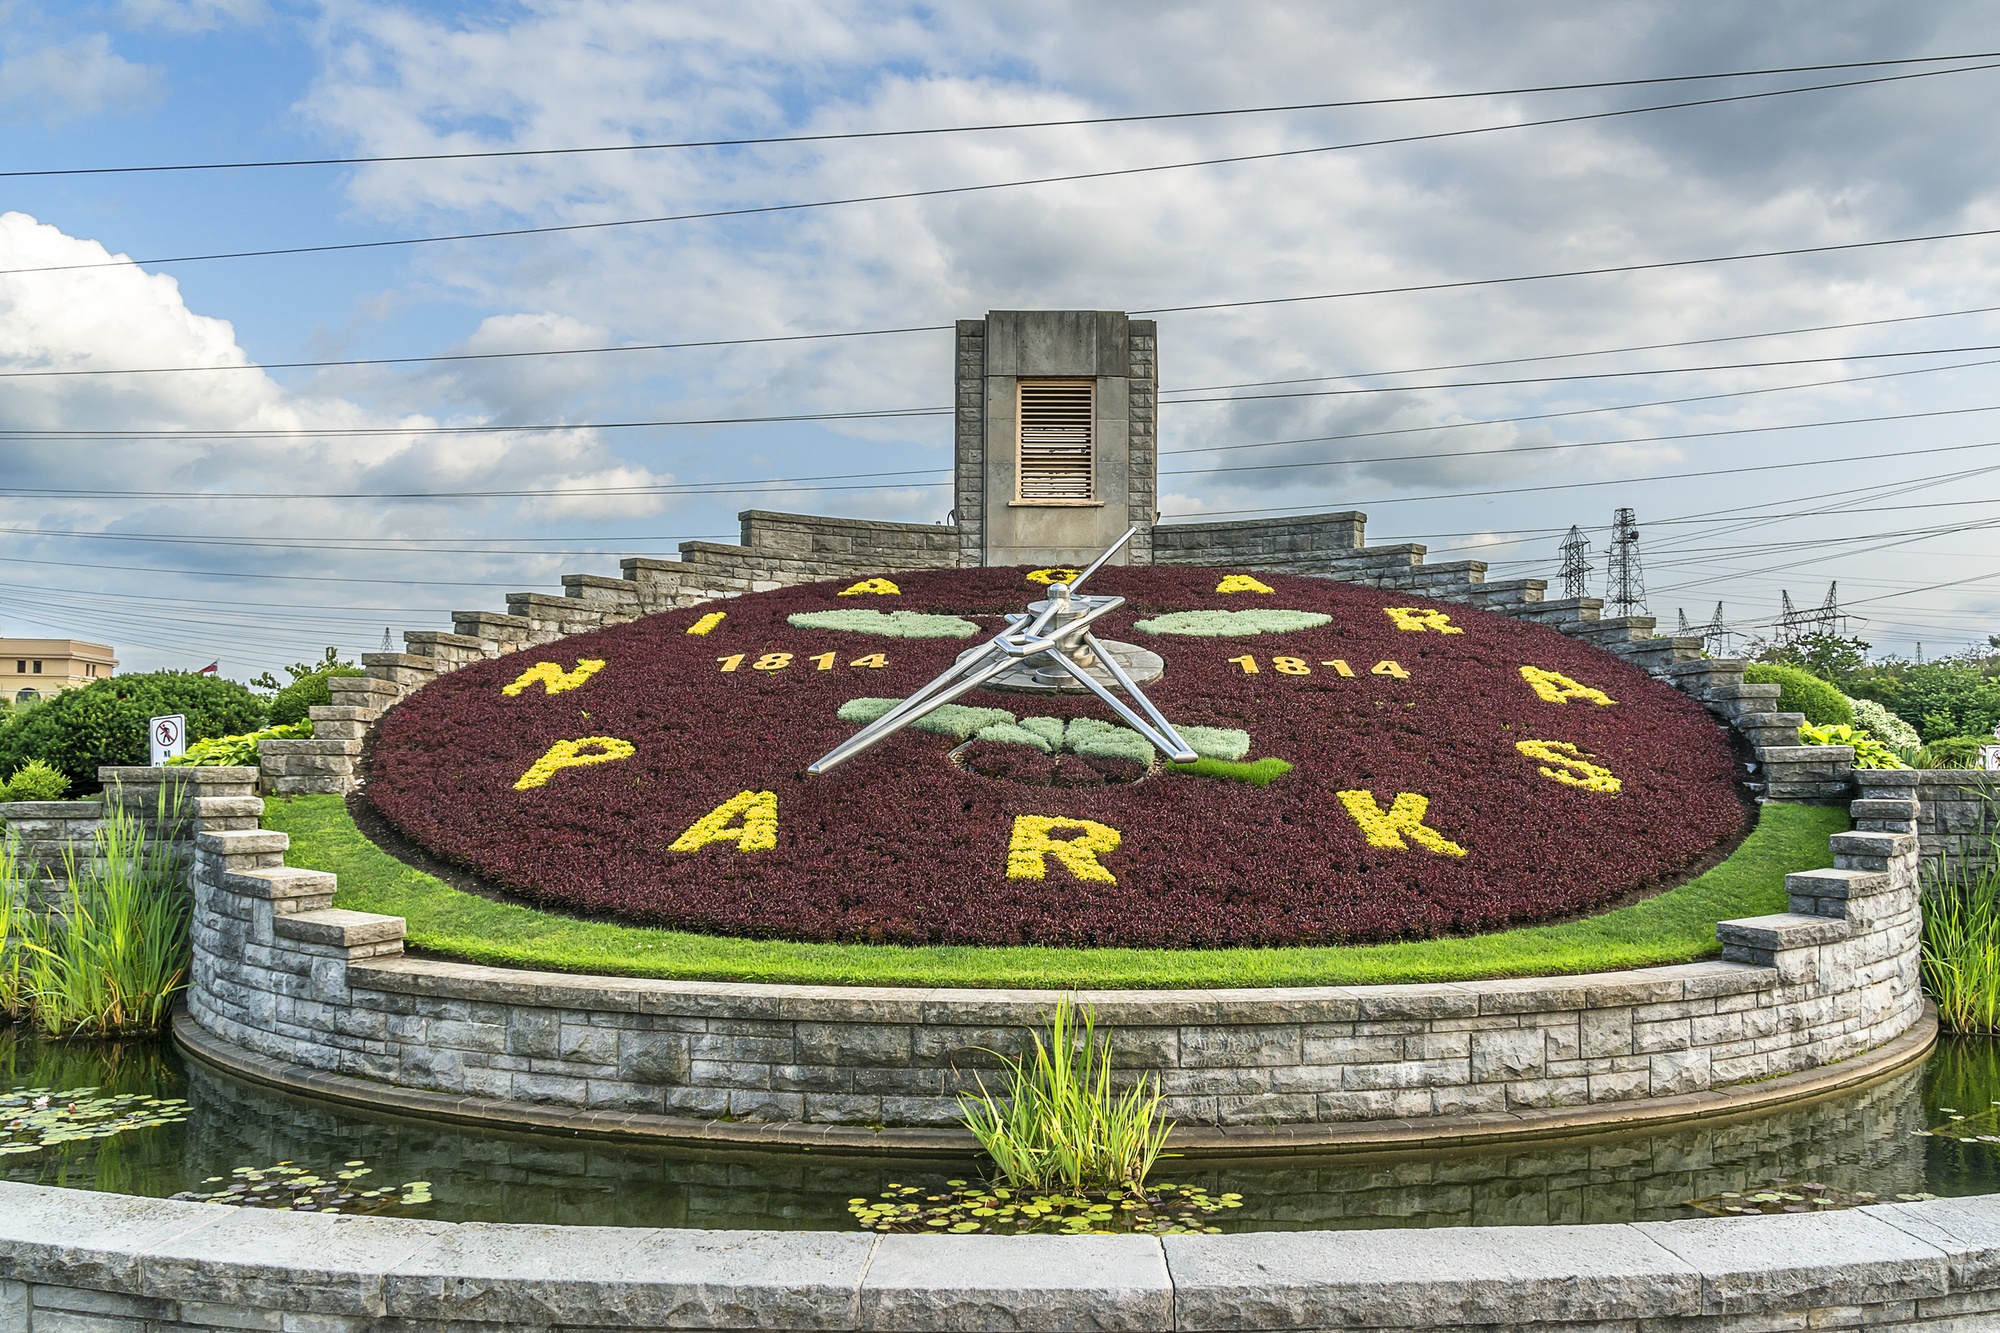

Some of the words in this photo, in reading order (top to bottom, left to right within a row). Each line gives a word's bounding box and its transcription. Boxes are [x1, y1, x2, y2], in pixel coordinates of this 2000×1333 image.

[717, 651, 889, 673] 1814
[1228, 655, 1412, 679] 1814
[514, 737, 1622, 885] PARKS
